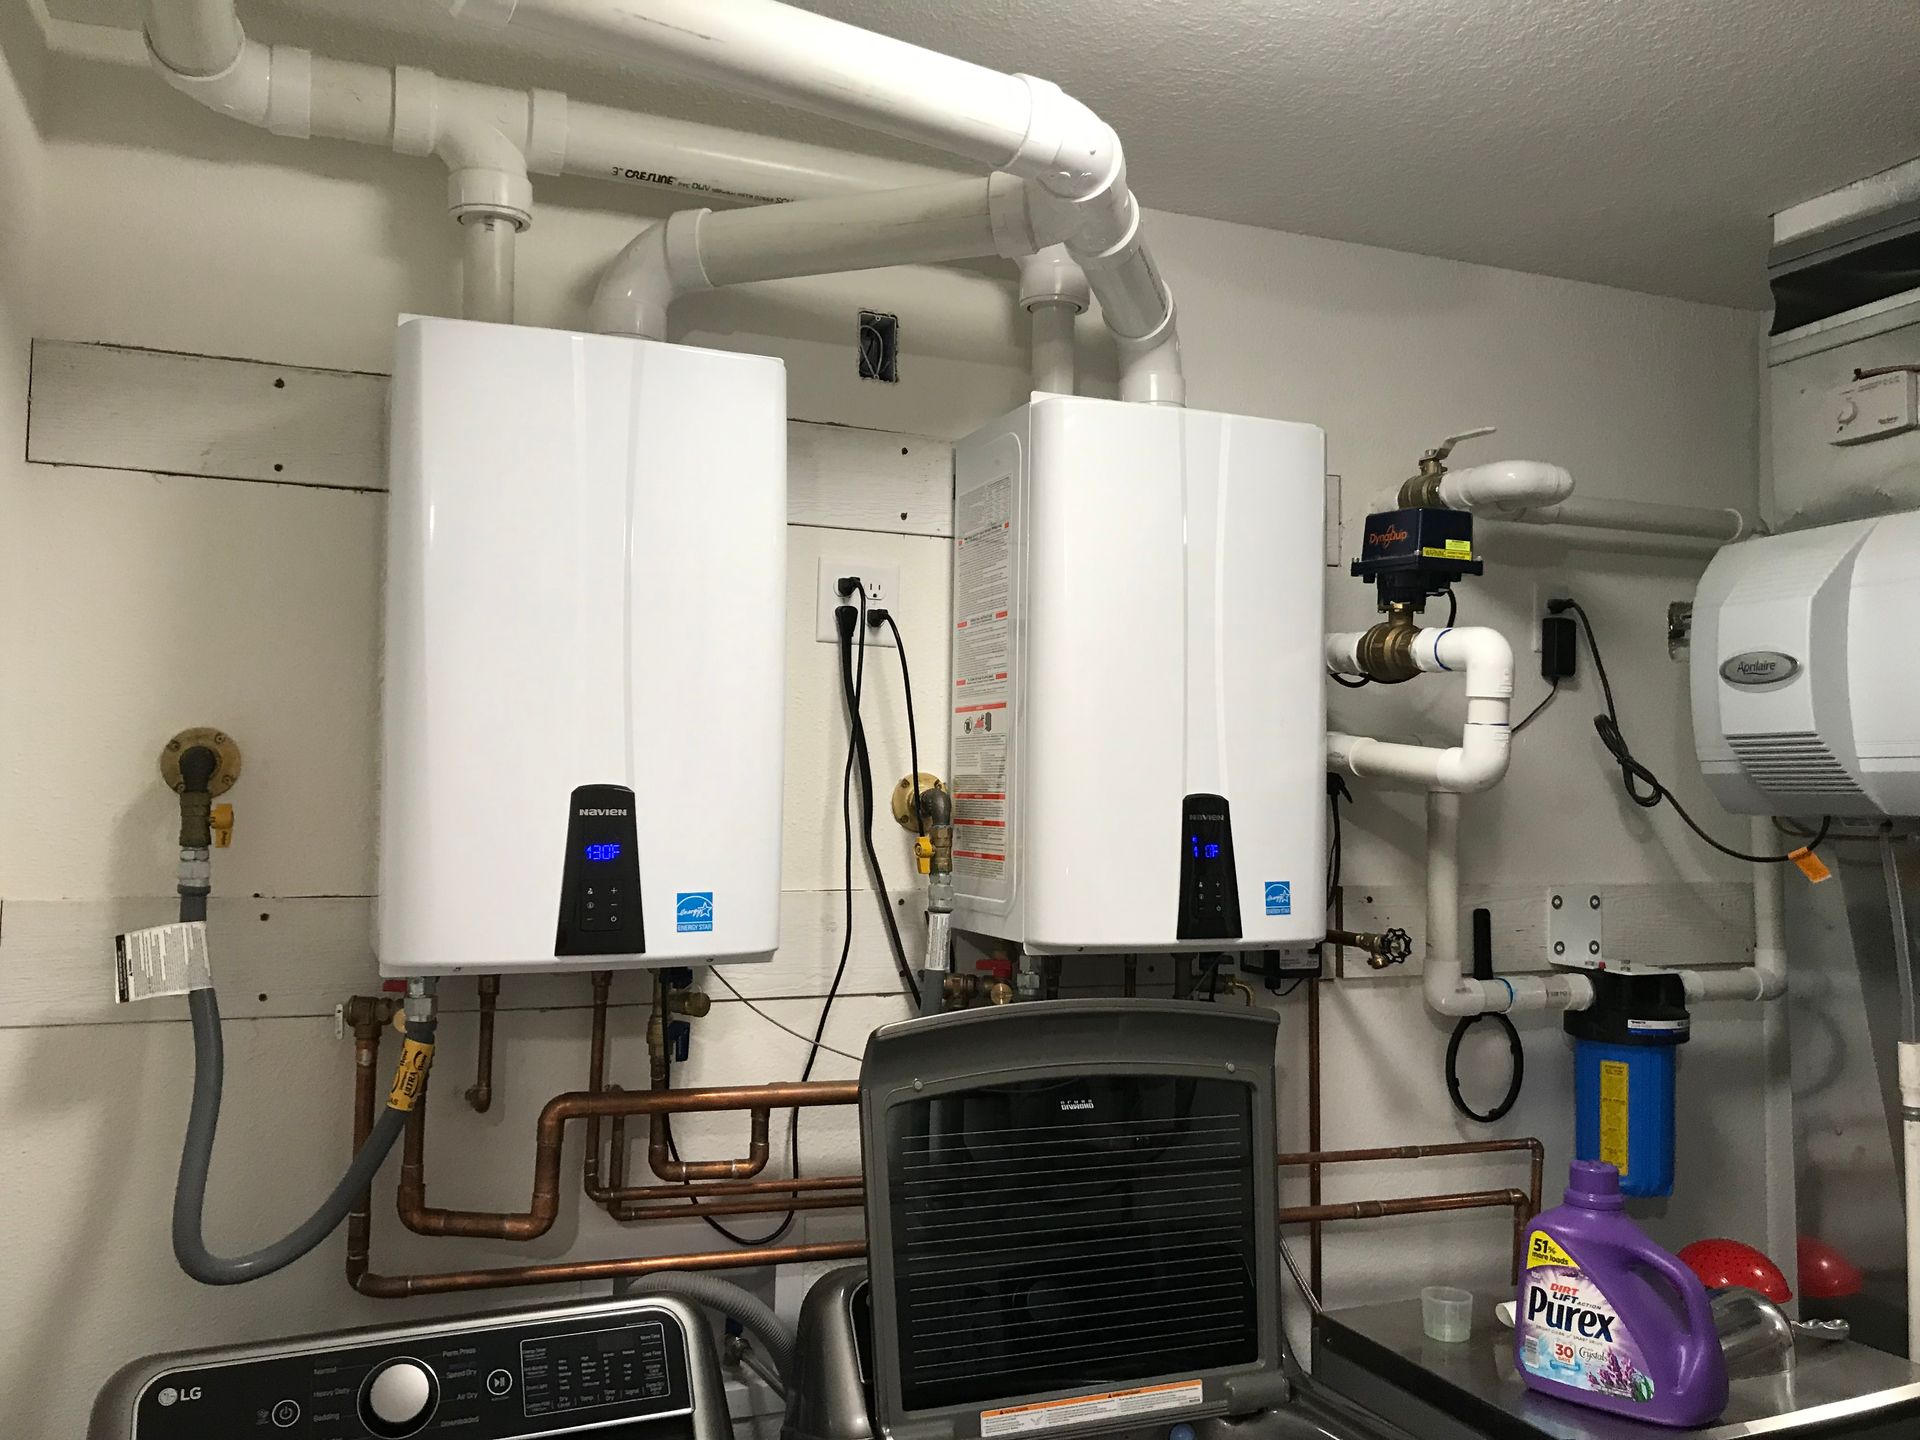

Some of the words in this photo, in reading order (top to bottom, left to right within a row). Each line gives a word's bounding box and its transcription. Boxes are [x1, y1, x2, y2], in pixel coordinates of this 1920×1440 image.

[1550, 1255, 1569, 1265] loads
[1550, 1283, 1579, 1295] DIRT
[1552, 1292, 1579, 1304] LIFT
[1577, 1301, 1602, 1310] ACTION
[1528, 1286, 1616, 1343] Purex
[1555, 1343, 1574, 1359] 30
[180, 1386, 202, 1401] LG
